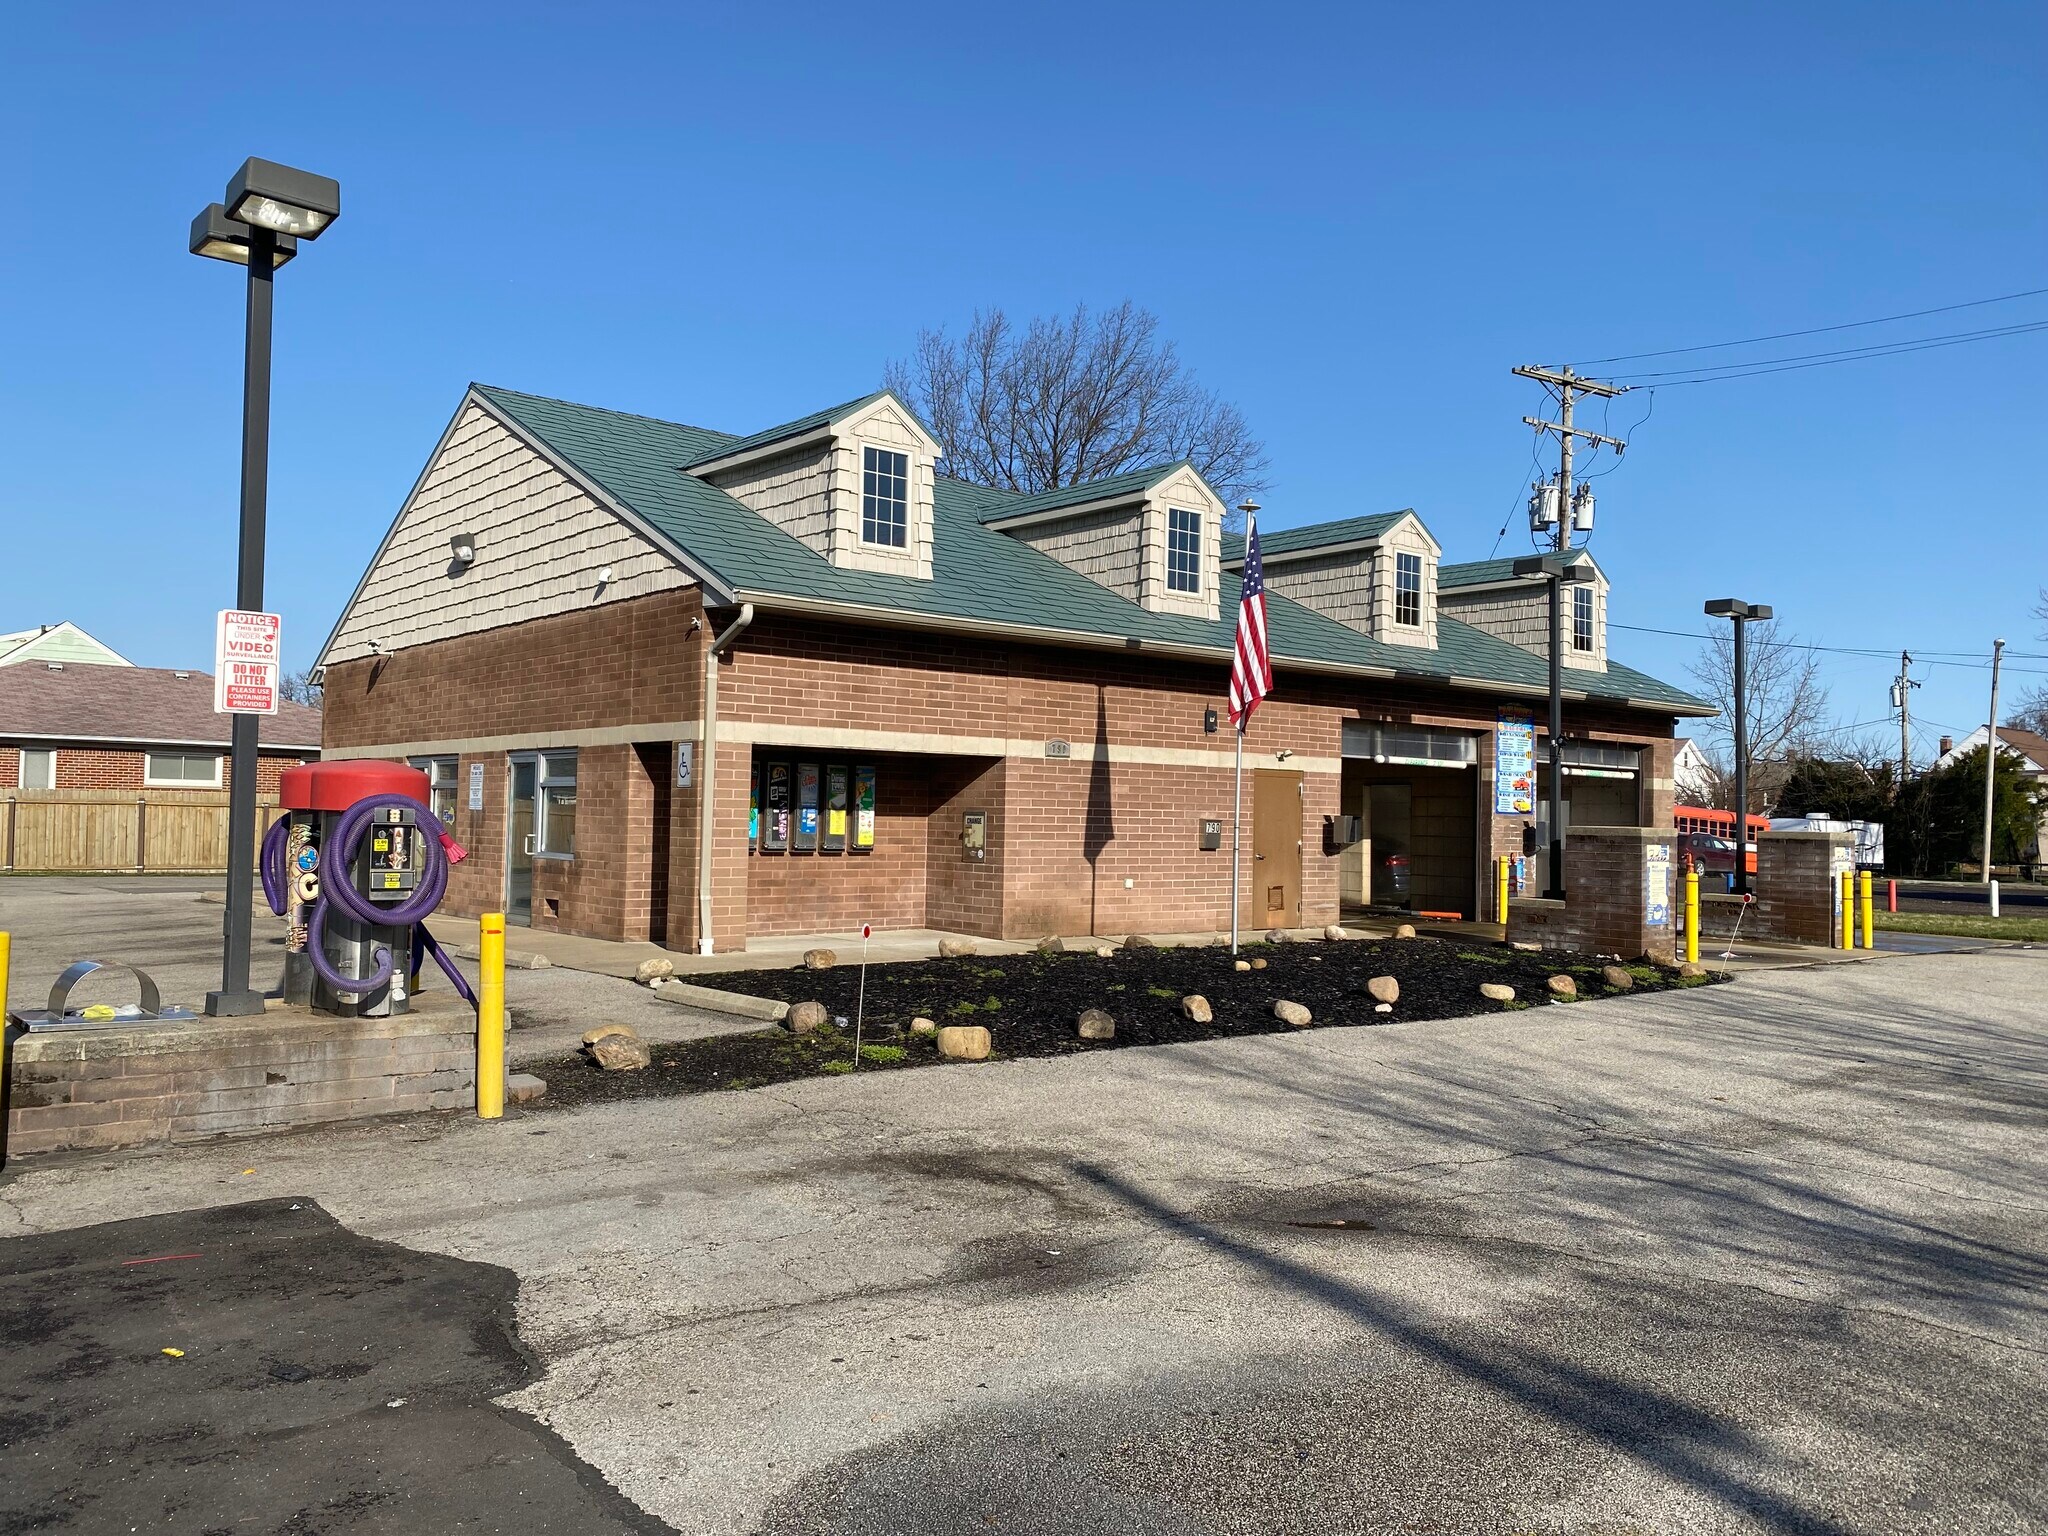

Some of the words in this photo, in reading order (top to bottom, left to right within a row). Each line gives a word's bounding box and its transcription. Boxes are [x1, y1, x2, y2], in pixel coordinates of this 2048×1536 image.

[228, 613, 275, 626] NOTICE:
[229, 641, 273, 653] VIDEO
[233, 664, 247, 674] DO
[249, 665, 268, 675] NOT
[234, 676, 265, 685] LITTER
[1207, 823, 1220, 833] 790
